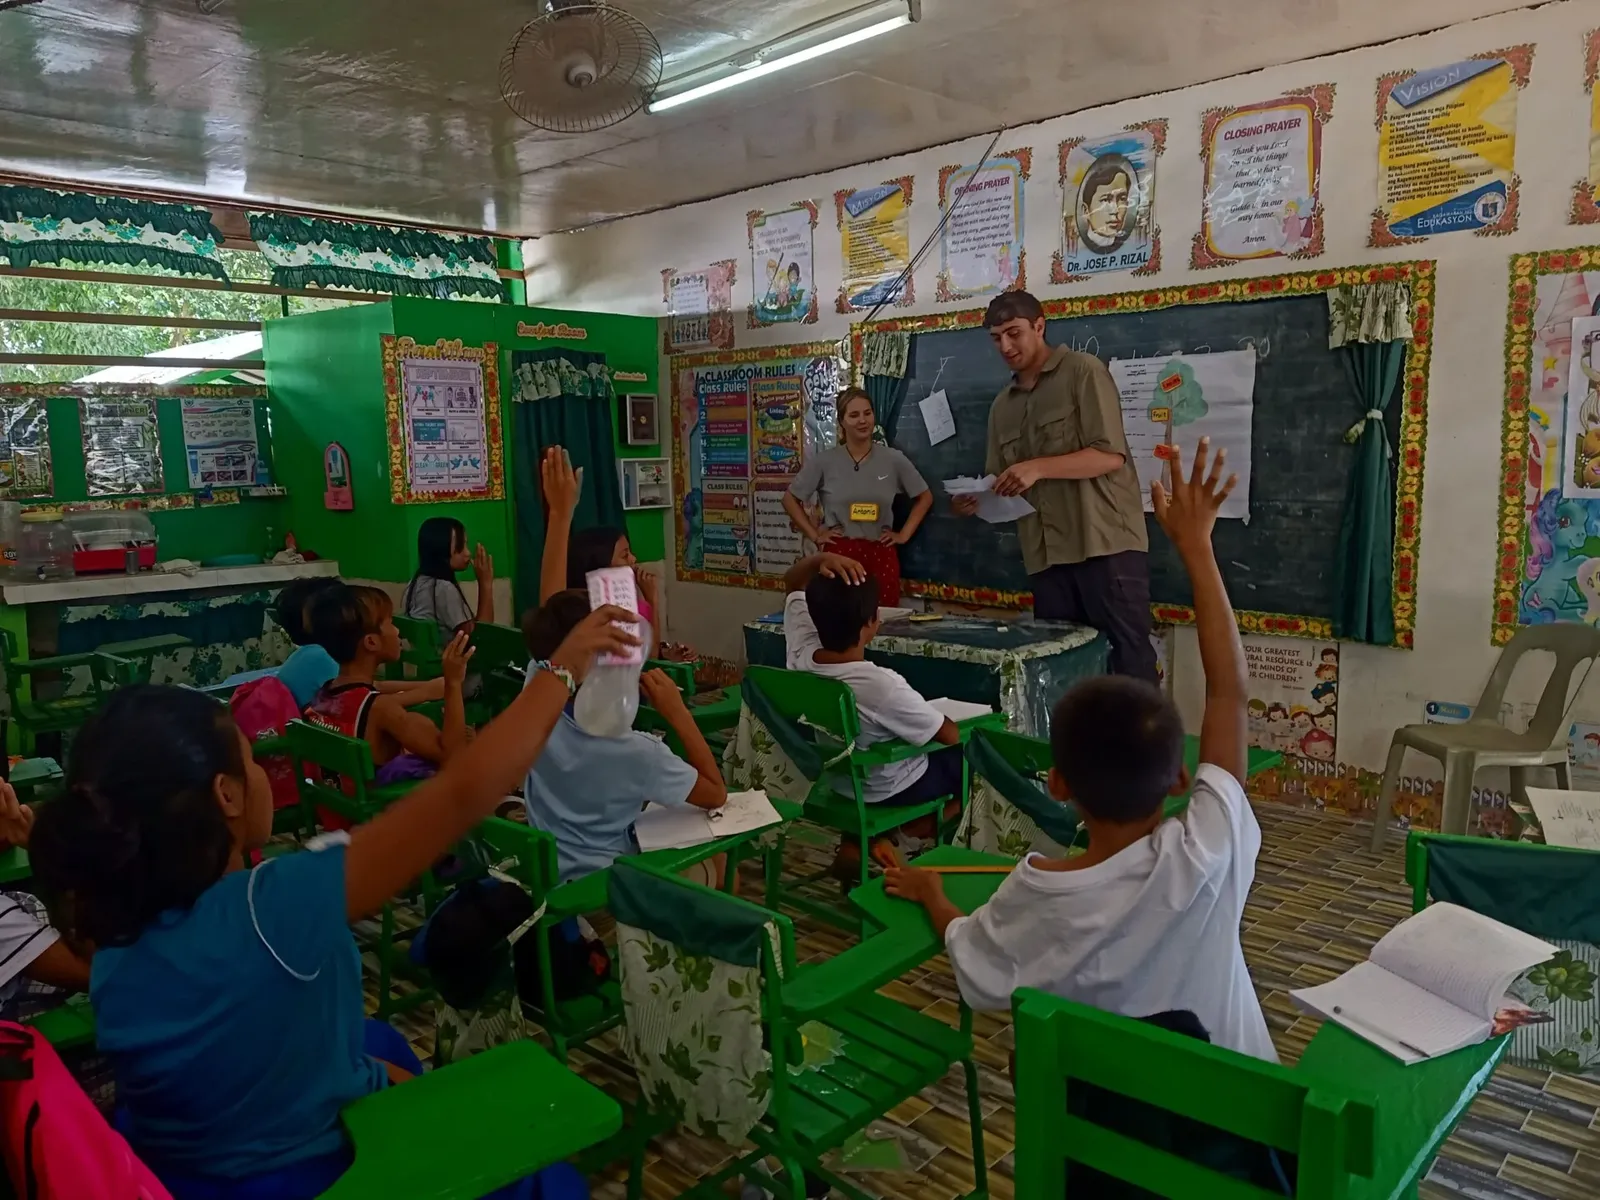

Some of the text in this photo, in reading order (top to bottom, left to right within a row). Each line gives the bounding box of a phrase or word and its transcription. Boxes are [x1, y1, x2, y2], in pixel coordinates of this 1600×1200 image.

[1400, 68, 1460, 100] VISION
[1224, 118, 1302, 140] CLOSING PRAYER
[1232, 144, 1254, 156] Thank
[1255, 144, 1270, 153] you
[1252, 152, 1288, 162] the things
[984, 176, 1010, 190] PRAYER
[852, 188, 888, 214] MISYON
[1270, 199, 1283, 207] our
[1238, 213, 1252, 223] way
[1417, 214, 1473, 228] EDUKASYON
[1242, 234, 1267, 244] Amen.
[1067, 252, 1149, 272] DR. JOSE P. RIZAL
[518, 322, 586, 339] Comfort Room
[705, 364, 795, 382] CLASSROOM RULES
[700, 382, 747, 394] Class Rules
[753, 381, 800, 392] Class Rules
[1264, 647, 1300, 658] GREATEST
[1265, 656, 1304, 666] RESOURCE
[1260, 664, 1284, 672] MINDS
[1430, 704, 1435, 712] 1
